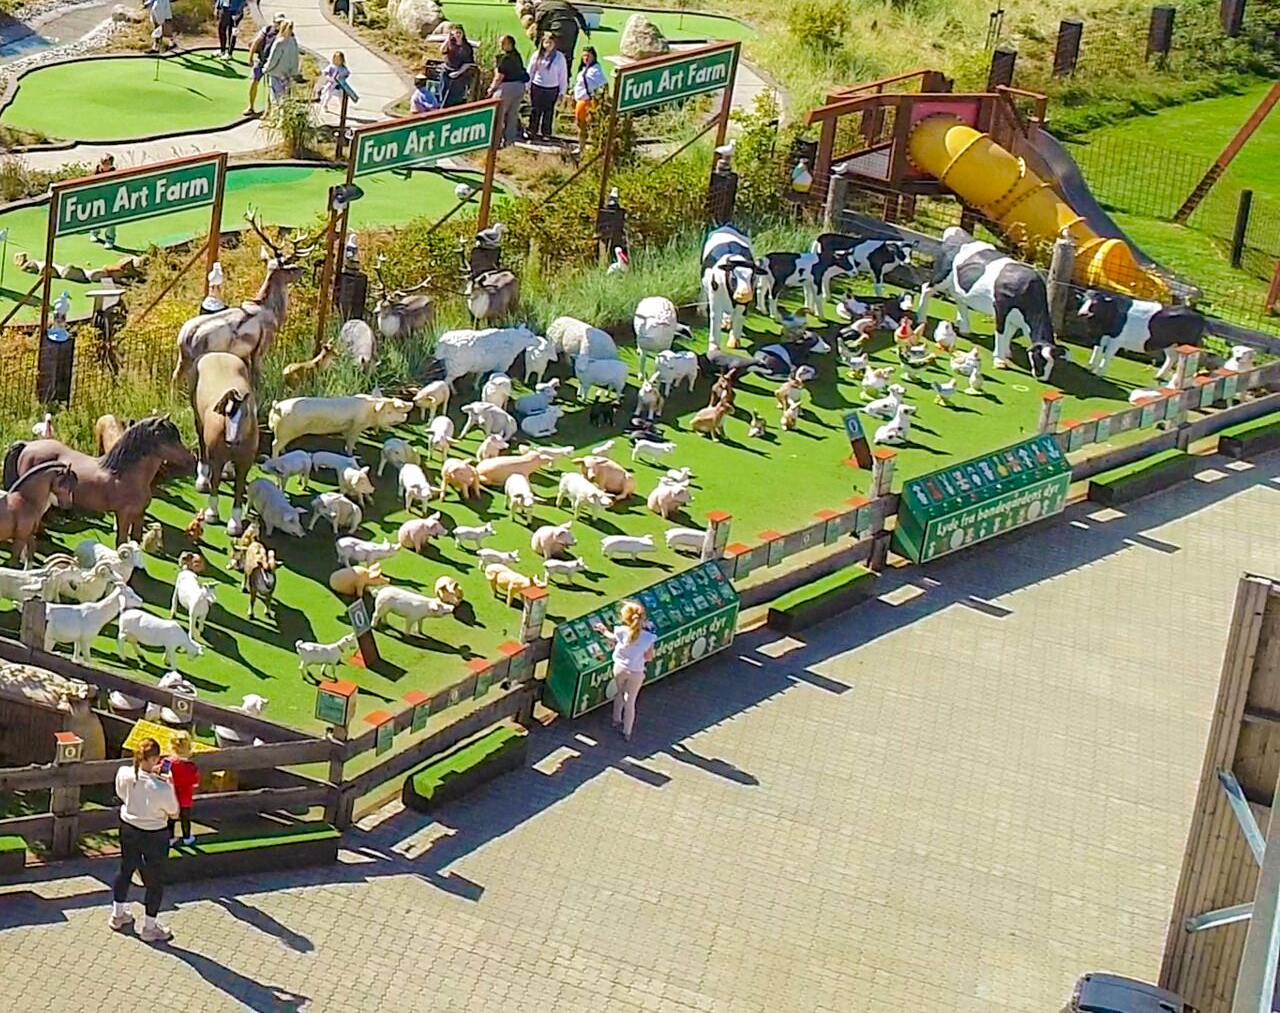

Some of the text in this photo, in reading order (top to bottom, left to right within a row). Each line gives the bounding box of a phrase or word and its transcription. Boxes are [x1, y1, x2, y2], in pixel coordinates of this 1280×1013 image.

[624, 62, 726, 101] Fun Art Farm
[362, 122, 486, 164] Fun Art Farm
[64, 176, 208, 222] Fun Art Farm
[936, 483, 1060, 536] Lyde fra bondegårdens dyr
[653, 624, 707, 658] degårdens
[709, 615, 727, 634] dyr
